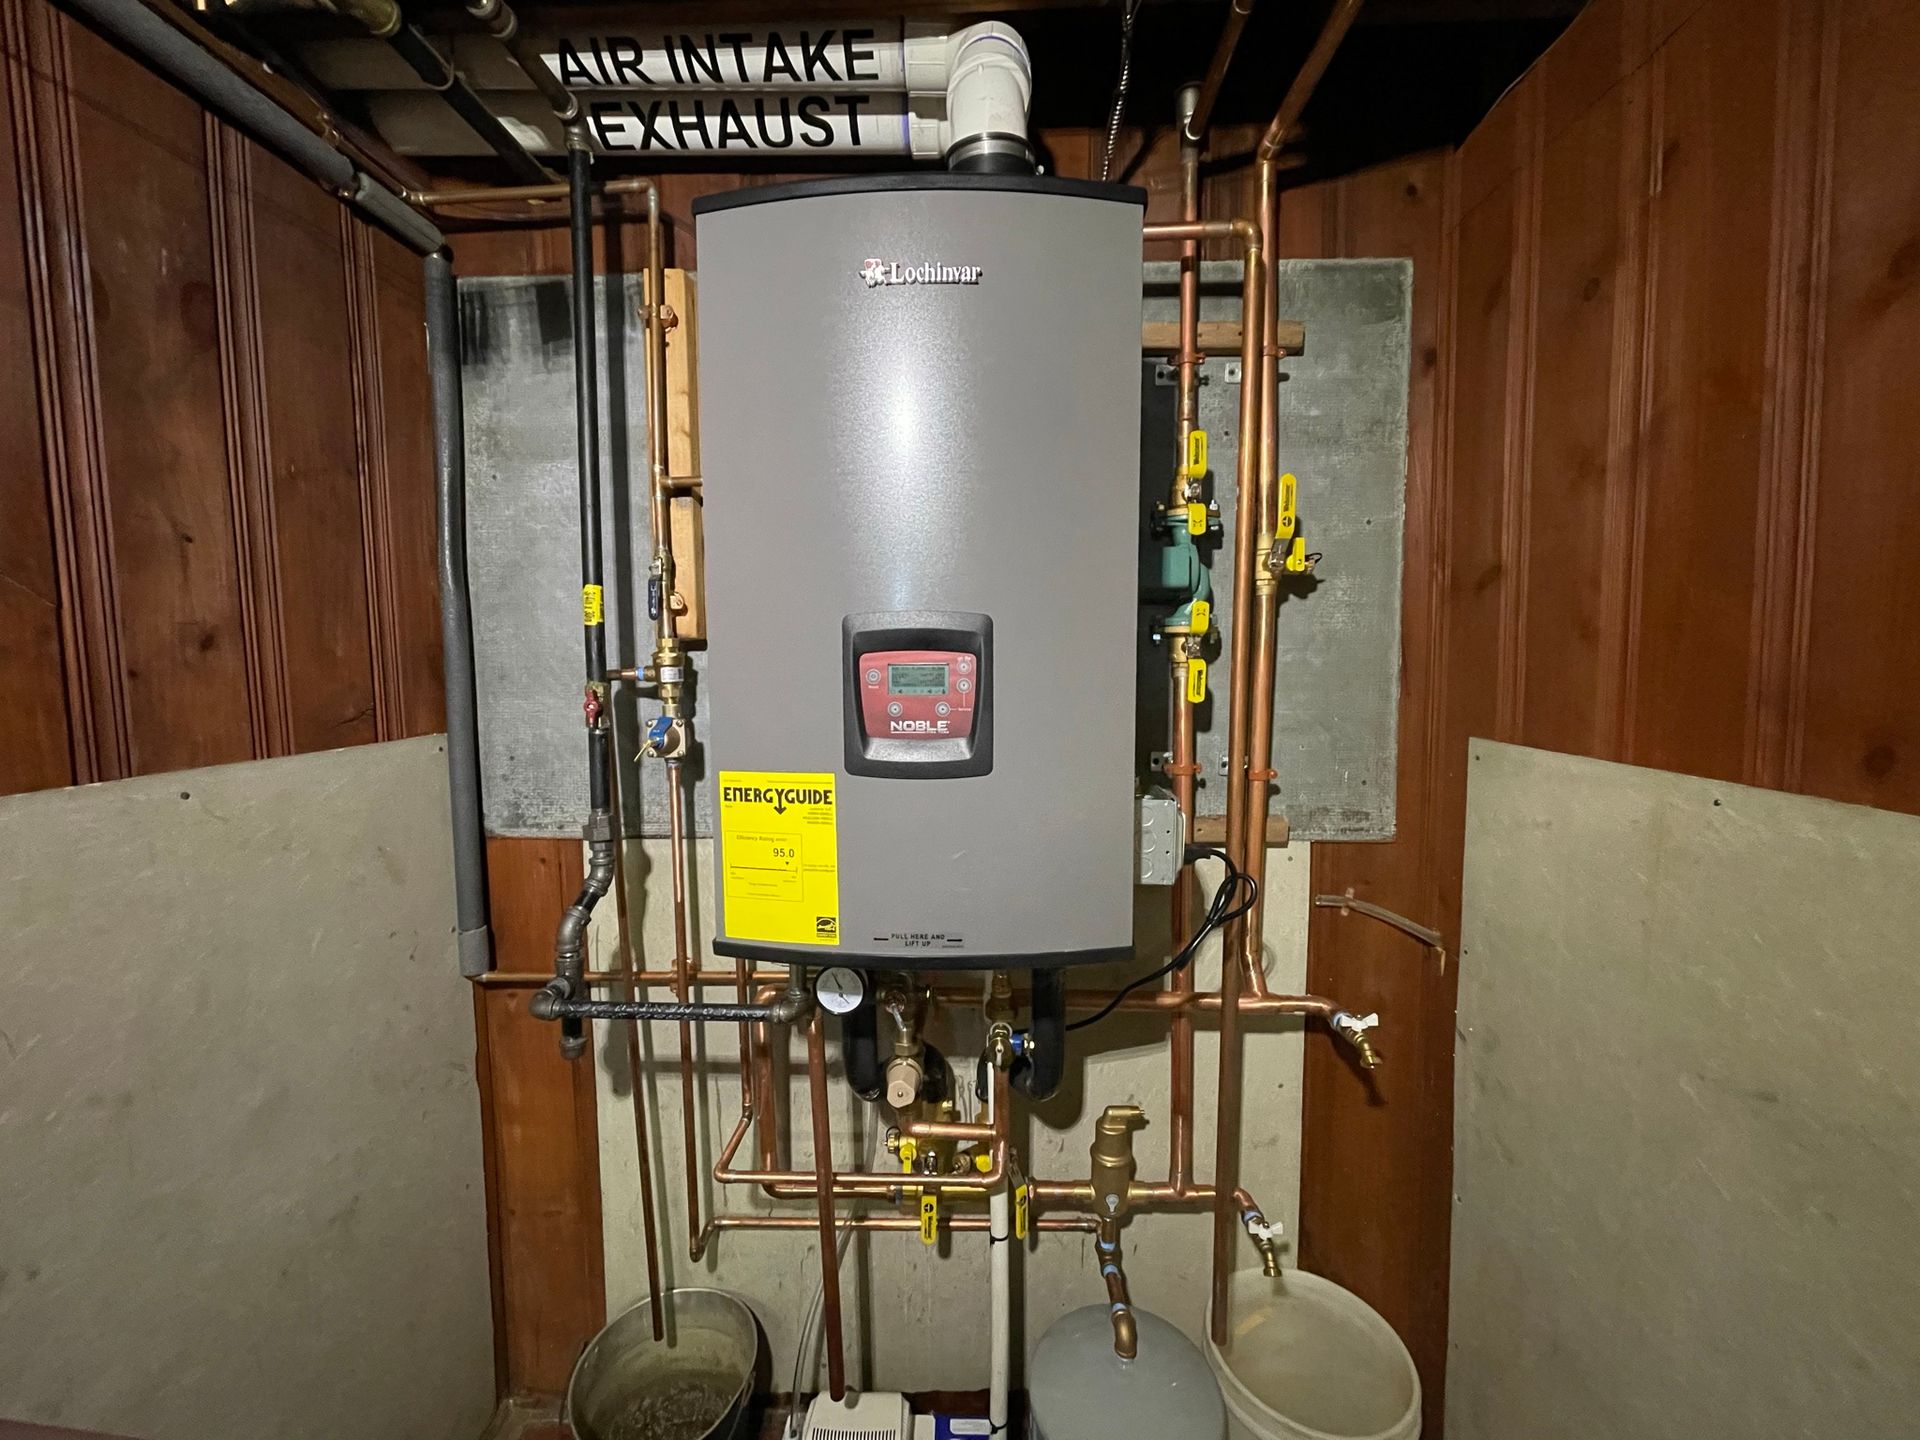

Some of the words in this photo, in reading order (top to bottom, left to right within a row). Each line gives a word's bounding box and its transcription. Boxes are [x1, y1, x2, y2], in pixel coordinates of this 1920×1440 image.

[558, 35, 657, 86] AIR
[663, 29, 880, 85] INTAKE
[589, 95, 870, 150] EXHAUST
[889, 261, 982, 284] Lochinvar
[890, 720, 949, 732] NOBLE
[773, 847, 795, 858] 95.0
